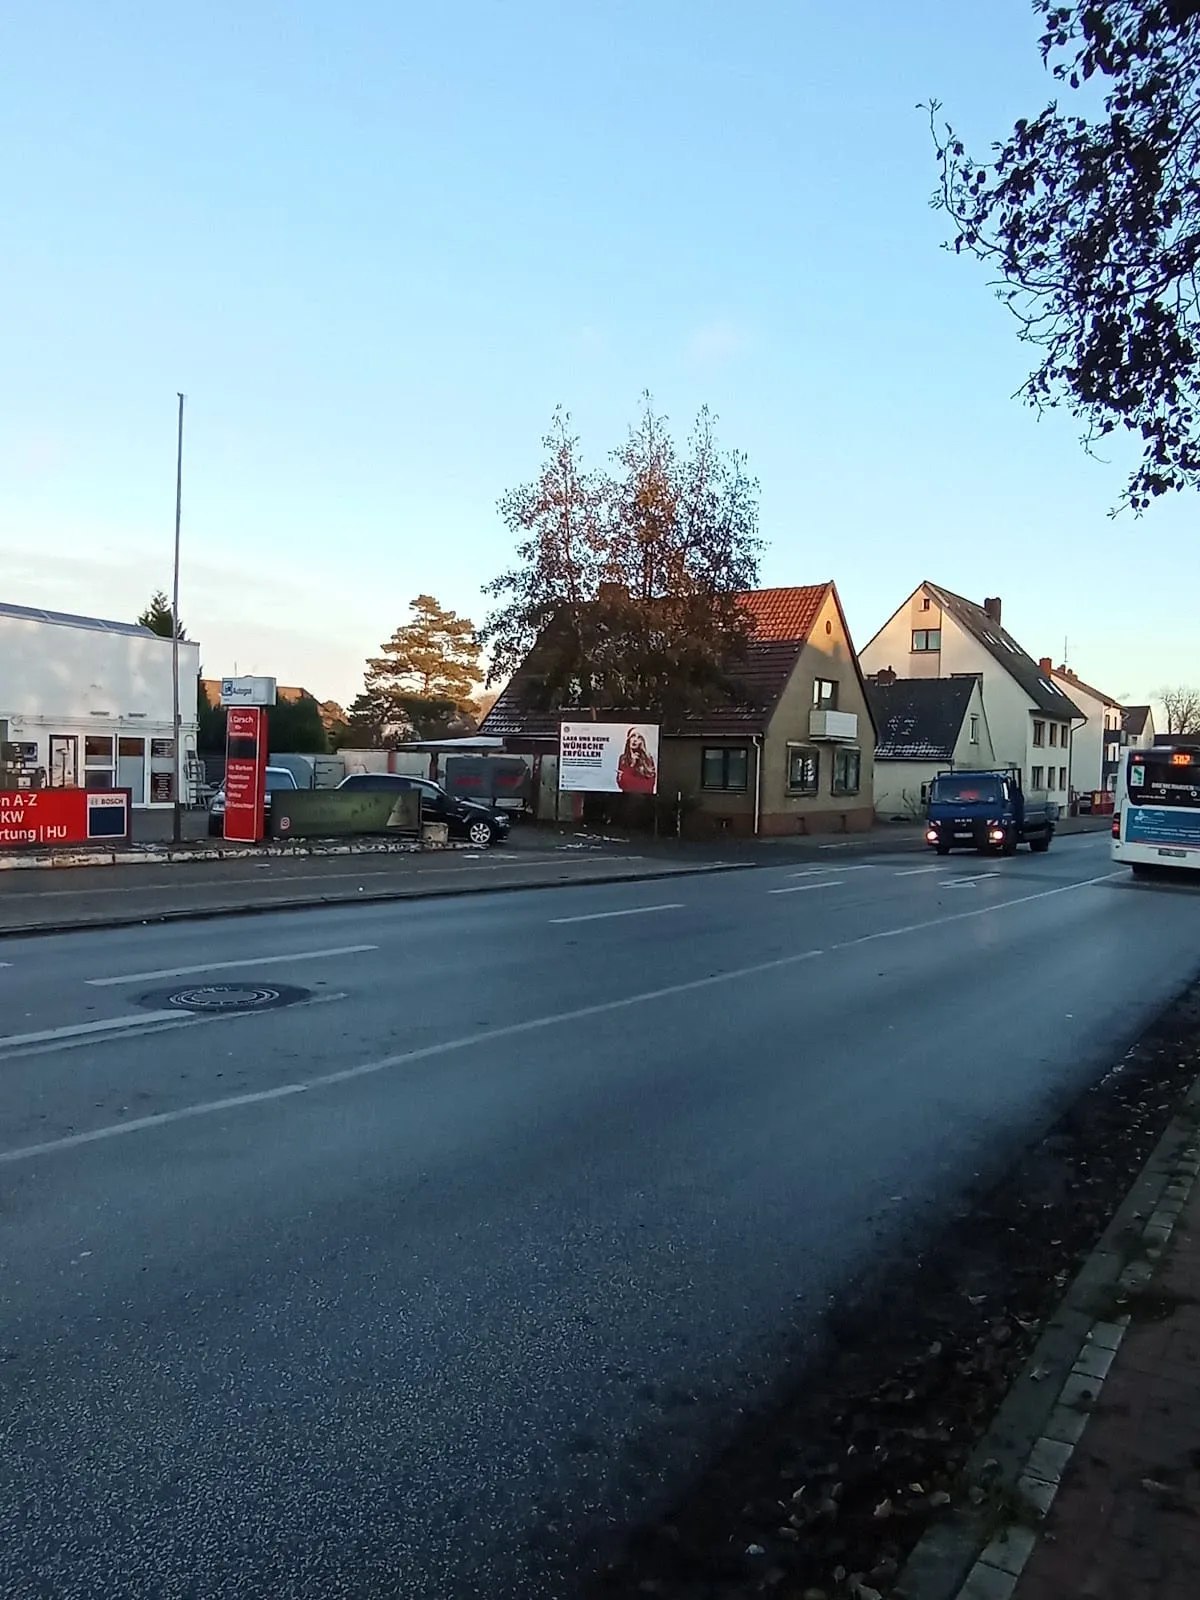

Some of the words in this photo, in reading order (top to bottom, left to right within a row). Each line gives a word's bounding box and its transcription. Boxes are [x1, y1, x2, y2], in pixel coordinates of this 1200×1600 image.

[562, 741, 604, 750] WÜNSCHE
[13, 793, 38, 807] A-Z
[46, 825, 67, 838] HU
